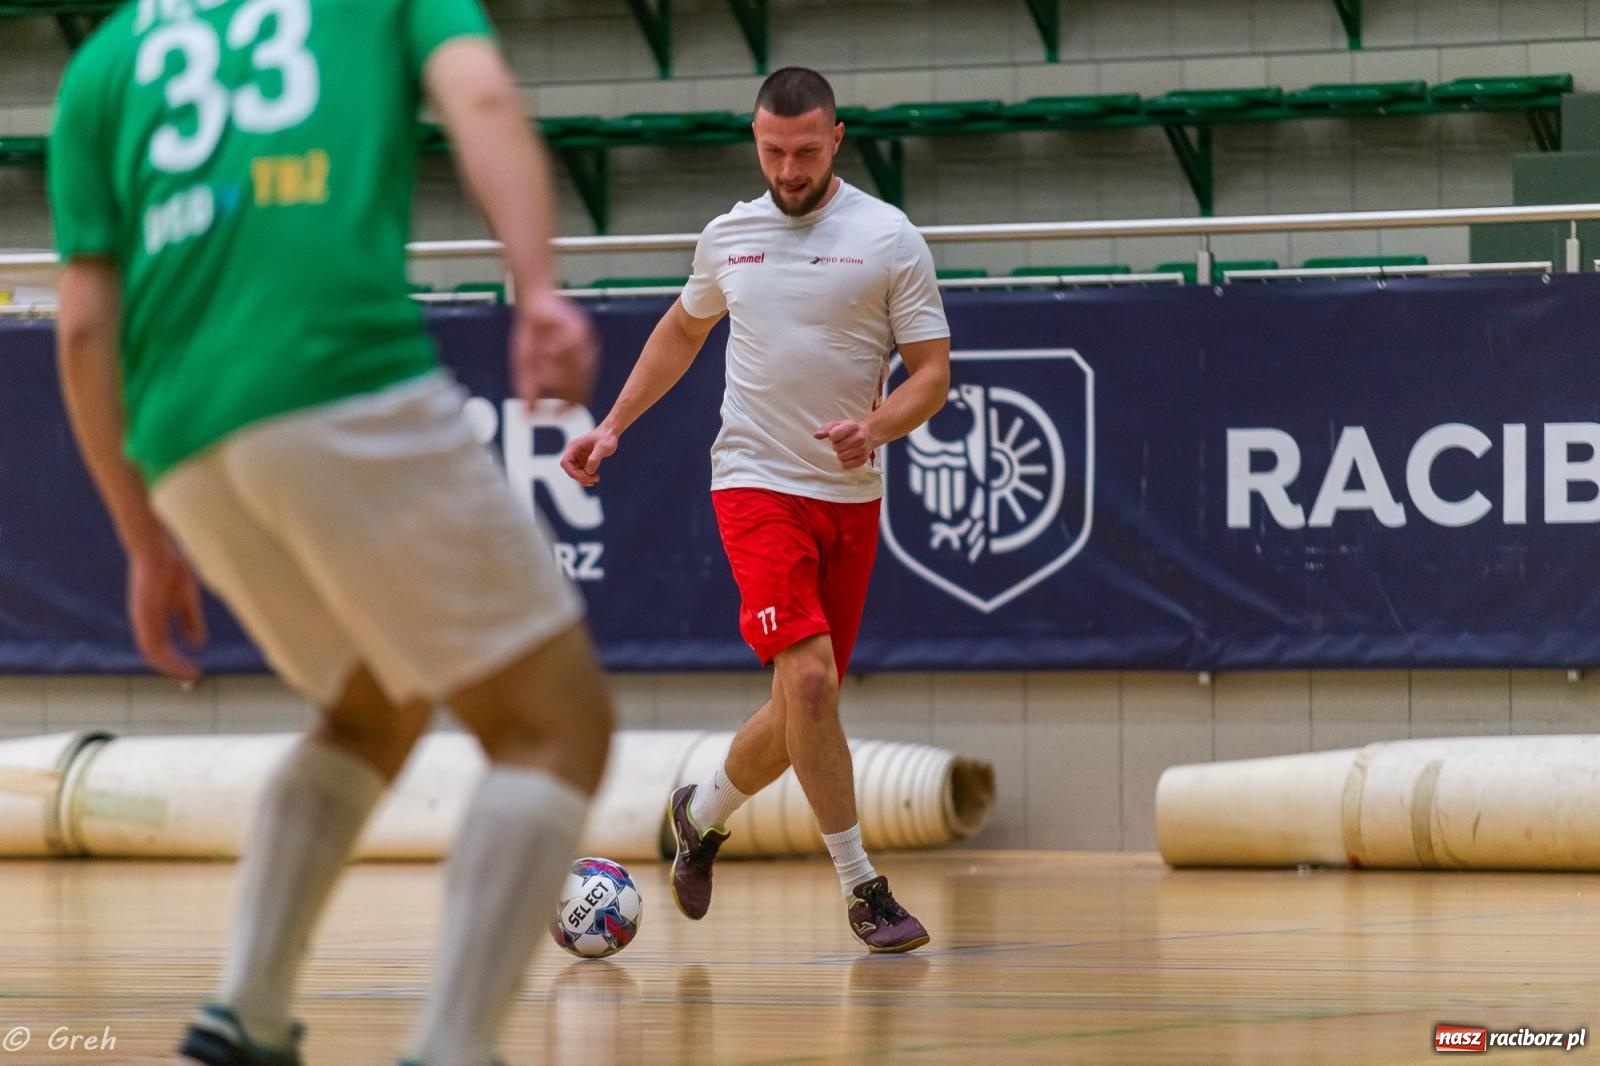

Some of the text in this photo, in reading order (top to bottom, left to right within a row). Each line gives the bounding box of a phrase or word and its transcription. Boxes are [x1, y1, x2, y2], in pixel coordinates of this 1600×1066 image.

[134, 0, 320, 173] 33
[728, 252, 765, 266] hummel
[1226, 421, 1600, 530] RACIB
[568, 881, 609, 928] SELECT
